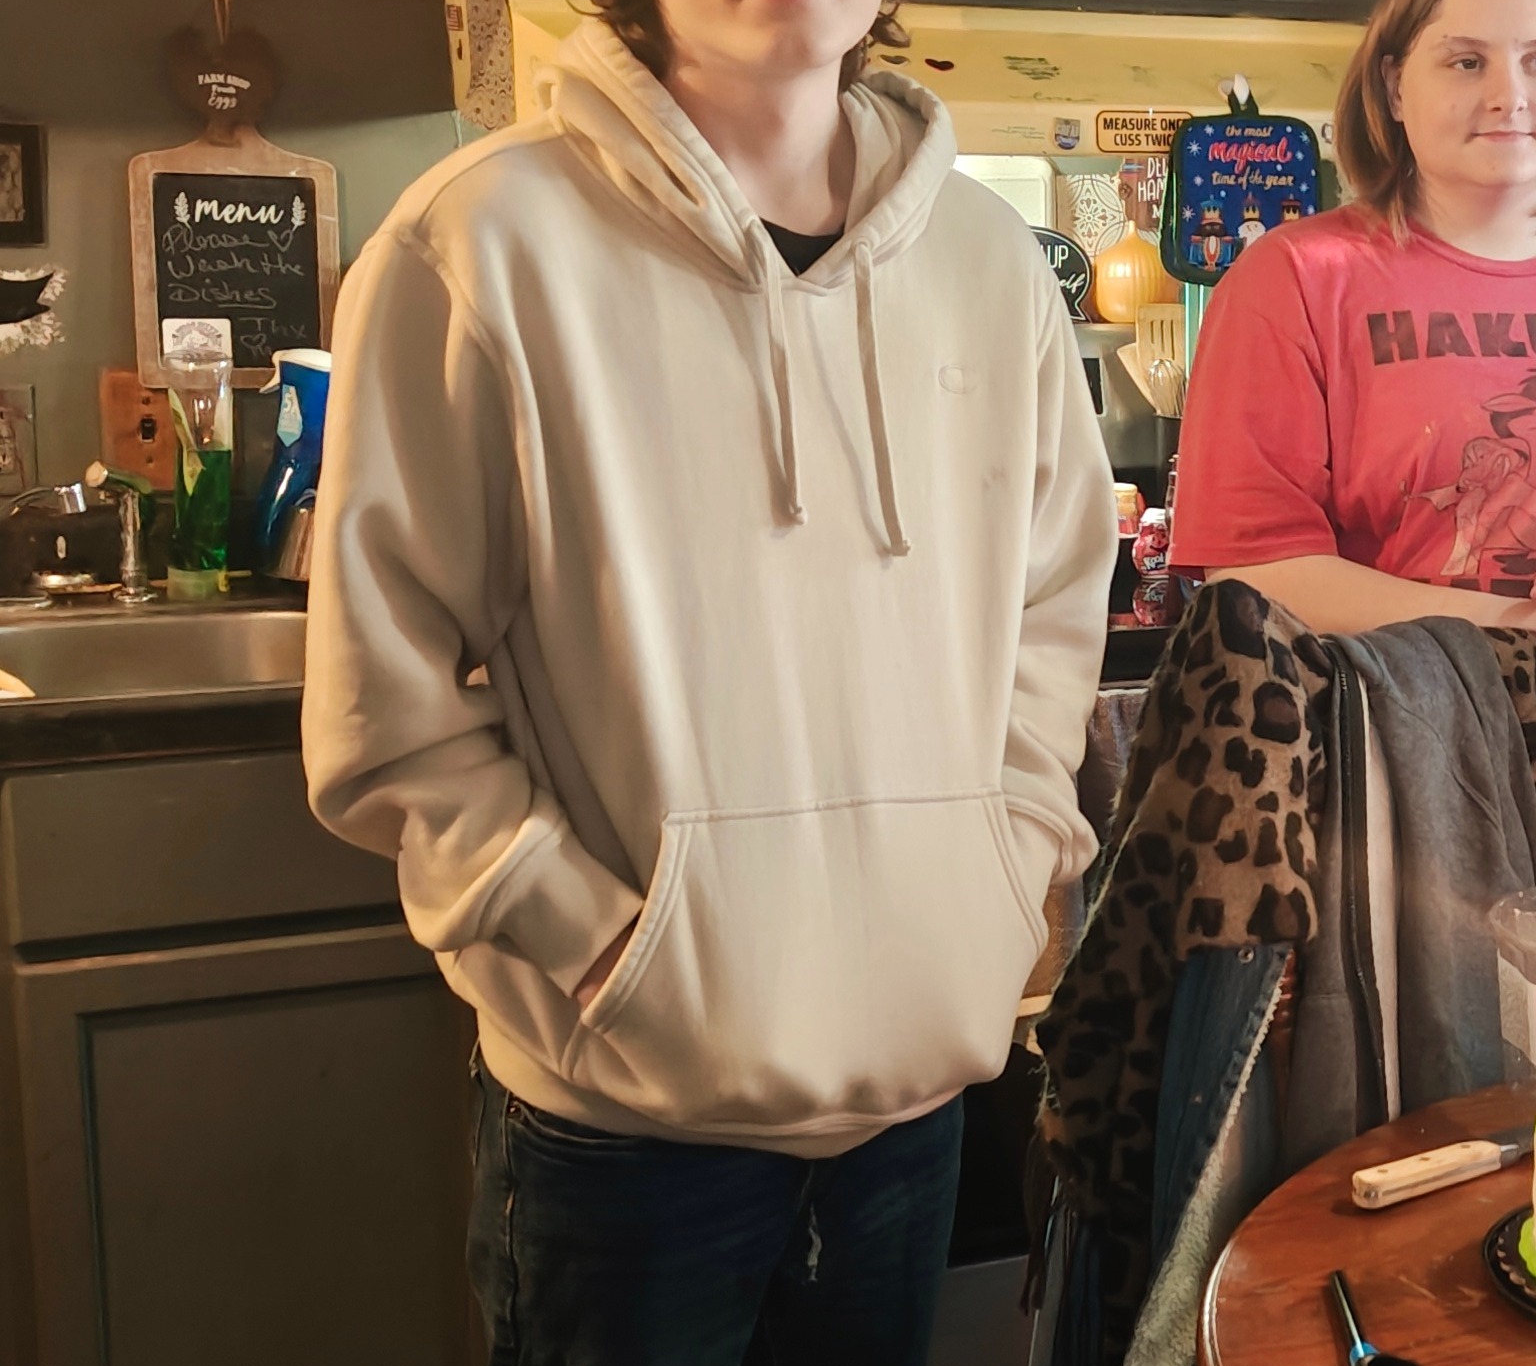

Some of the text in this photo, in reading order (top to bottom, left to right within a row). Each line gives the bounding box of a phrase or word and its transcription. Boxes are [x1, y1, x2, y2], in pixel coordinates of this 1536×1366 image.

[1103, 117, 1158, 132] MEASURE
[1225, 124, 1274, 138] the most
[1113, 133, 1173, 147] CUSS TWIC
[195, 198, 285, 224] menu
[162, 223, 270, 255] Please
[260, 252, 304, 276] the
[167, 278, 277, 309] Dishes
